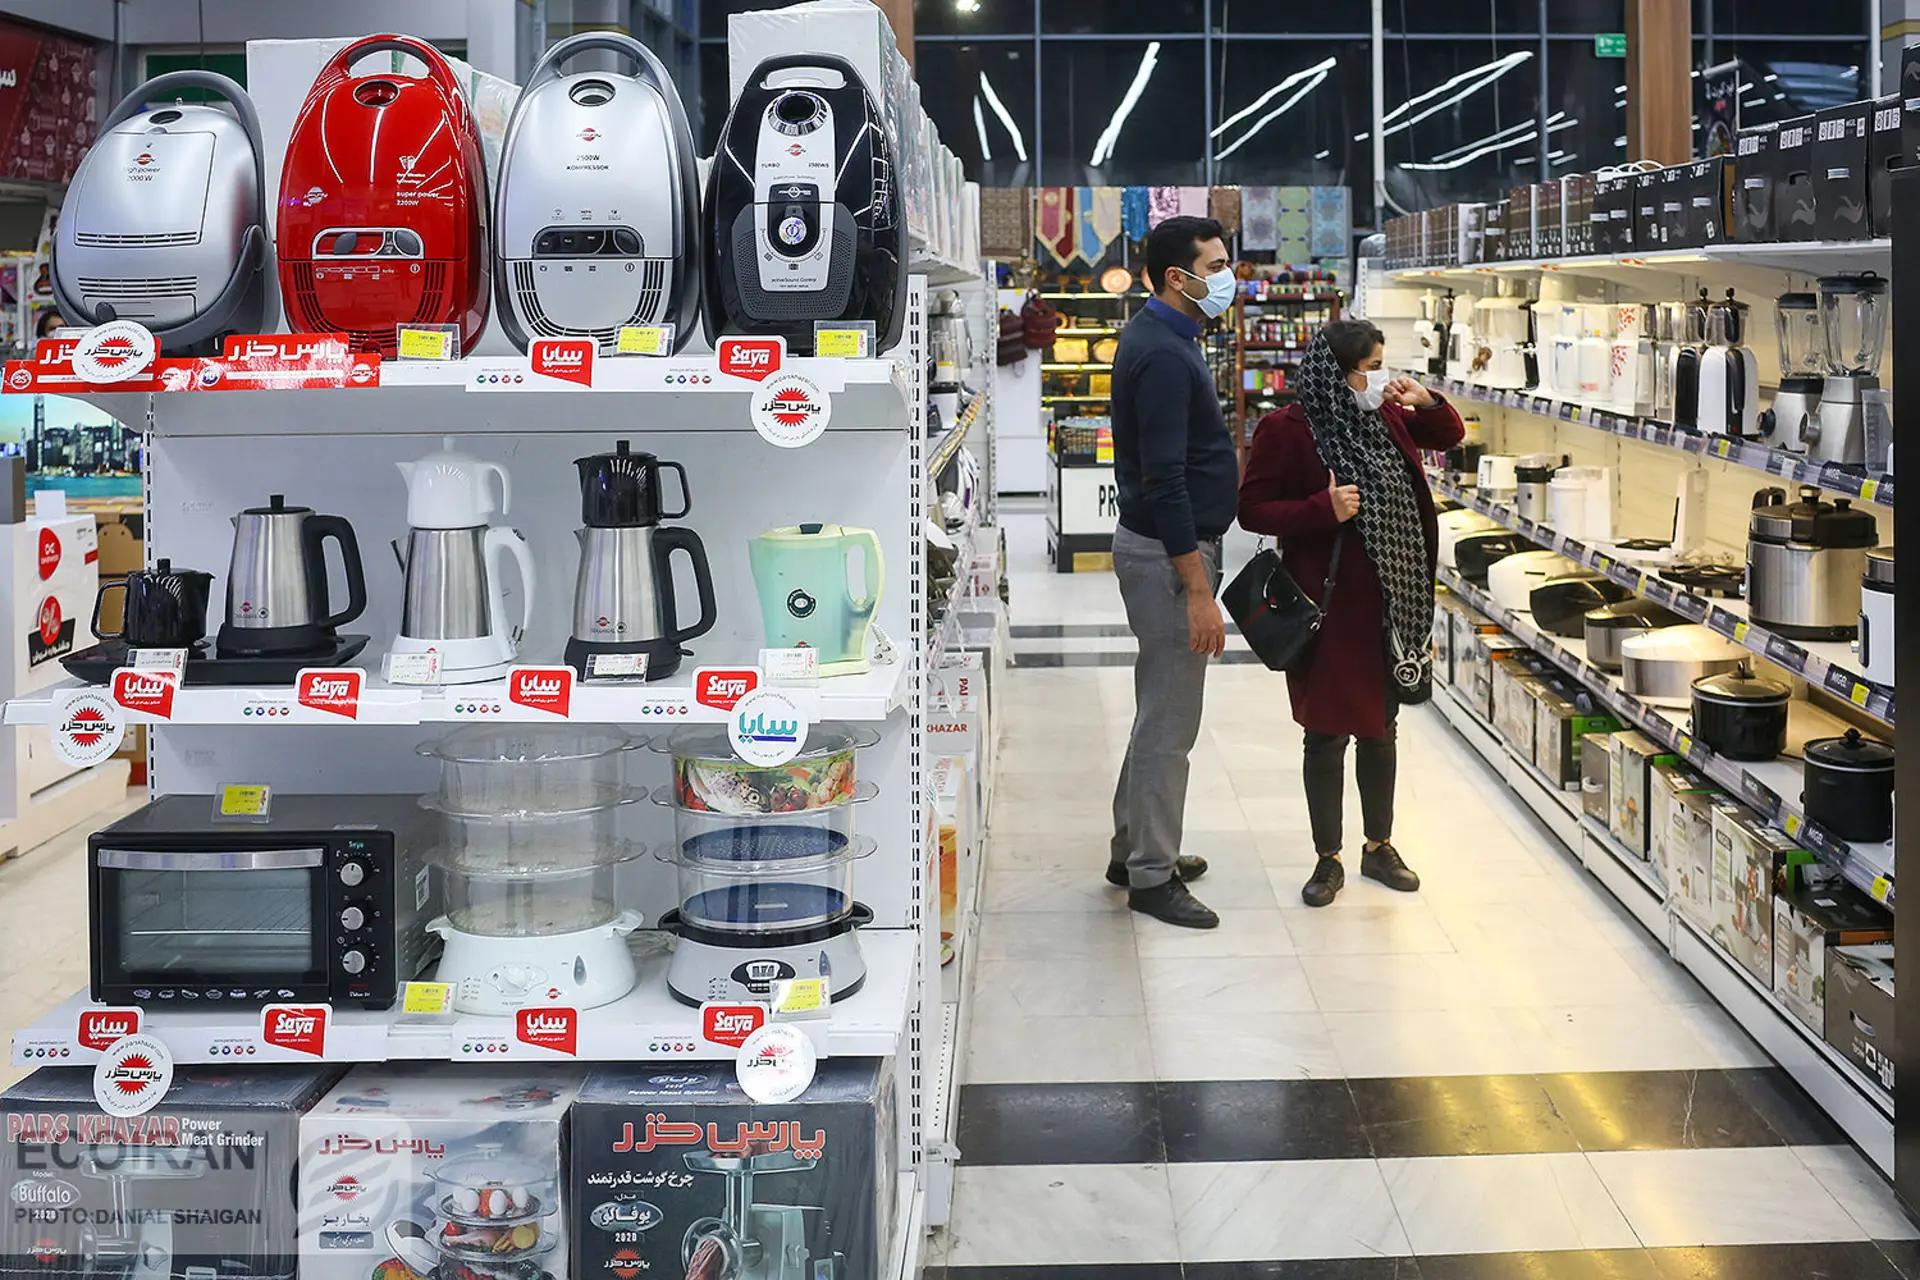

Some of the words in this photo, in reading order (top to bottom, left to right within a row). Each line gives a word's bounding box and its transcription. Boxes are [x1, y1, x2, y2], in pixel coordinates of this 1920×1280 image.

[397, 191, 416, 199] super
[84, 348, 110, 357] خزر
[110, 347, 143, 358] پارس
[228, 340, 278, 362] خزر
[279, 340, 347, 363] پارس
[730, 345, 770, 367] Saya
[761, 399, 787, 412] خزر
[787, 401, 821, 415] پارس
[1098, 485, 1117, 517] PR
[308, 676, 350, 699] Saya
[706, 675, 748, 698] Saya
[59, 721, 84, 732] خزر
[84, 722, 116, 734] پارس
[738, 711, 798, 744] سایا
[348, 841, 364, 849] Saya
[274, 1013, 316, 1037] Saya
[713, 1011, 754, 1034] Saya
[104, 1067, 130, 1080] خزر
[130, 1069, 163, 1083] پارس
[7, 1113, 70, 1145] PARS
[77, 1114, 181, 1147] KHAZAR
[181, 1117, 223, 1131] Power
[612, 1112, 704, 1152] خزر
[181, 1134, 214, 1147] Meat
[216, 1134, 265, 1147] Grinder
[318, 1134, 373, 1155] خزر
[375, 1136, 446, 1160] پارس
[707, 1120, 827, 1160] پارس
[587, 1170, 632, 1189] قدرتمند
[632, 1170, 668, 1189] گوشت
[667, 1170, 695, 1188] چرخ
[19, 1184, 71, 1203] Buffalo
[34, 1209, 57, 1220] 2020
[615, 1232, 638, 1243] 2020
[603, 1259, 624, 1270] خزر
[623, 1259, 650, 1271] پارس
